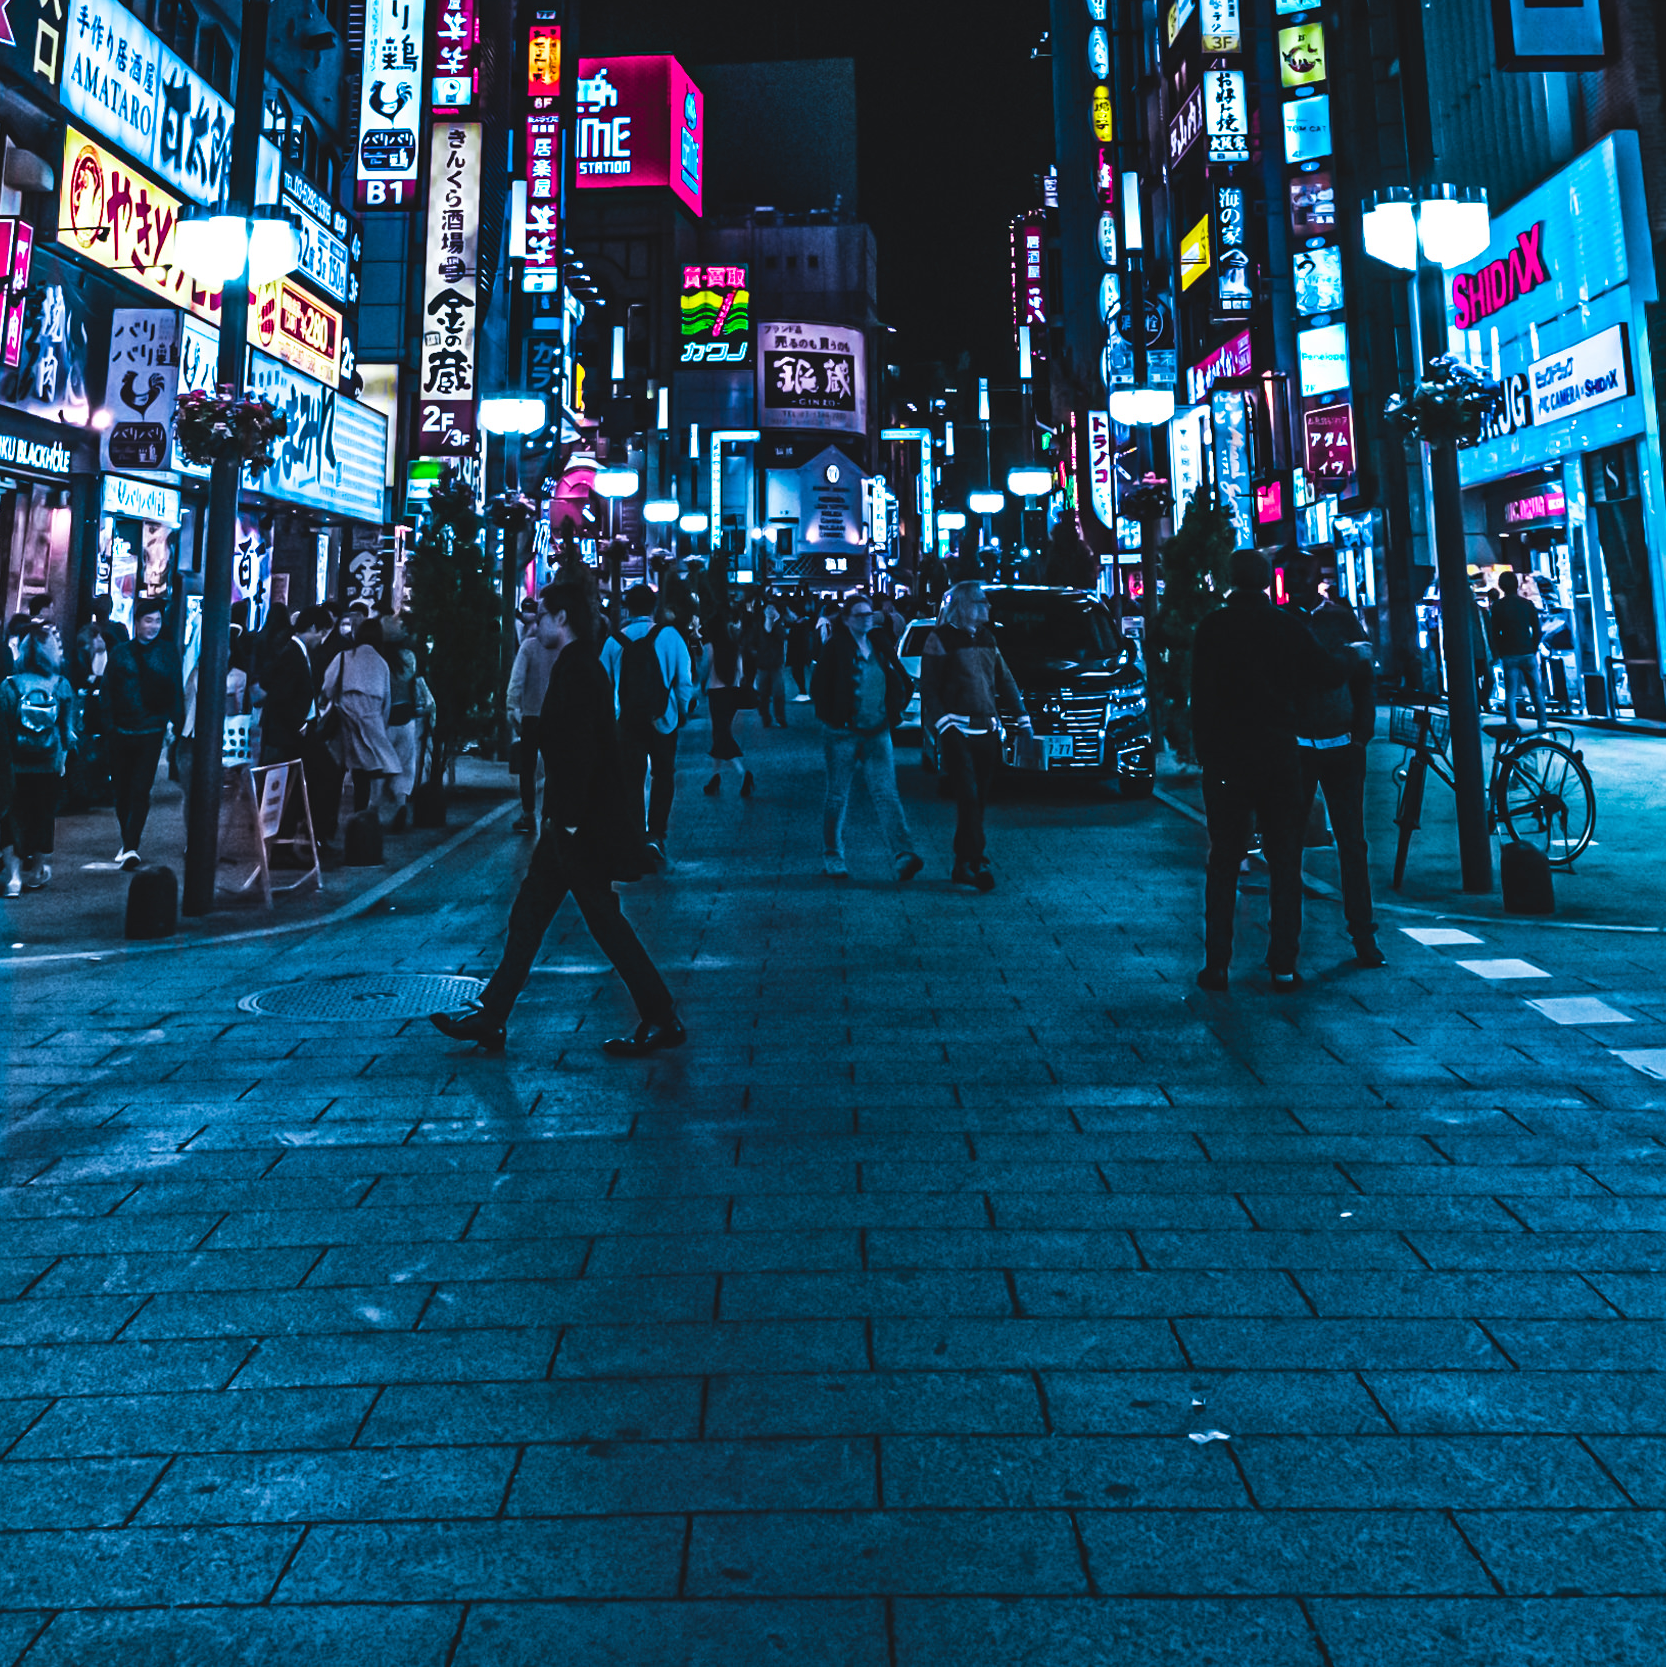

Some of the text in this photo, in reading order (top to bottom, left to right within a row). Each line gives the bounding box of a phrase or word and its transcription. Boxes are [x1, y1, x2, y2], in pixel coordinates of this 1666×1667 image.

[76, 2, 156, 98] 手作り居酒屋
[1212, 36, 1233, 49] 3F
[69, 50, 153, 138] AMATARO
[366, 181, 404, 205] B1
[437, 129, 467, 255] きんくら酒場
[533, 137, 553, 198] 居楽屋
[579, 160, 631, 175] STATION
[1219, 188, 1242, 245] 海の家
[1452, 222, 1548, 331] SHIDAX
[37, 284, 66, 403] 焼肉
[340, 336, 355, 381] 2F
[423, 287, 475, 395] 金の蔵
[680, 341, 749, 362] カワノ
[773, 356, 852, 399] 銀蔵
[421, 405, 455, 433] 2F
[1309, 431, 1349, 448] アダム
